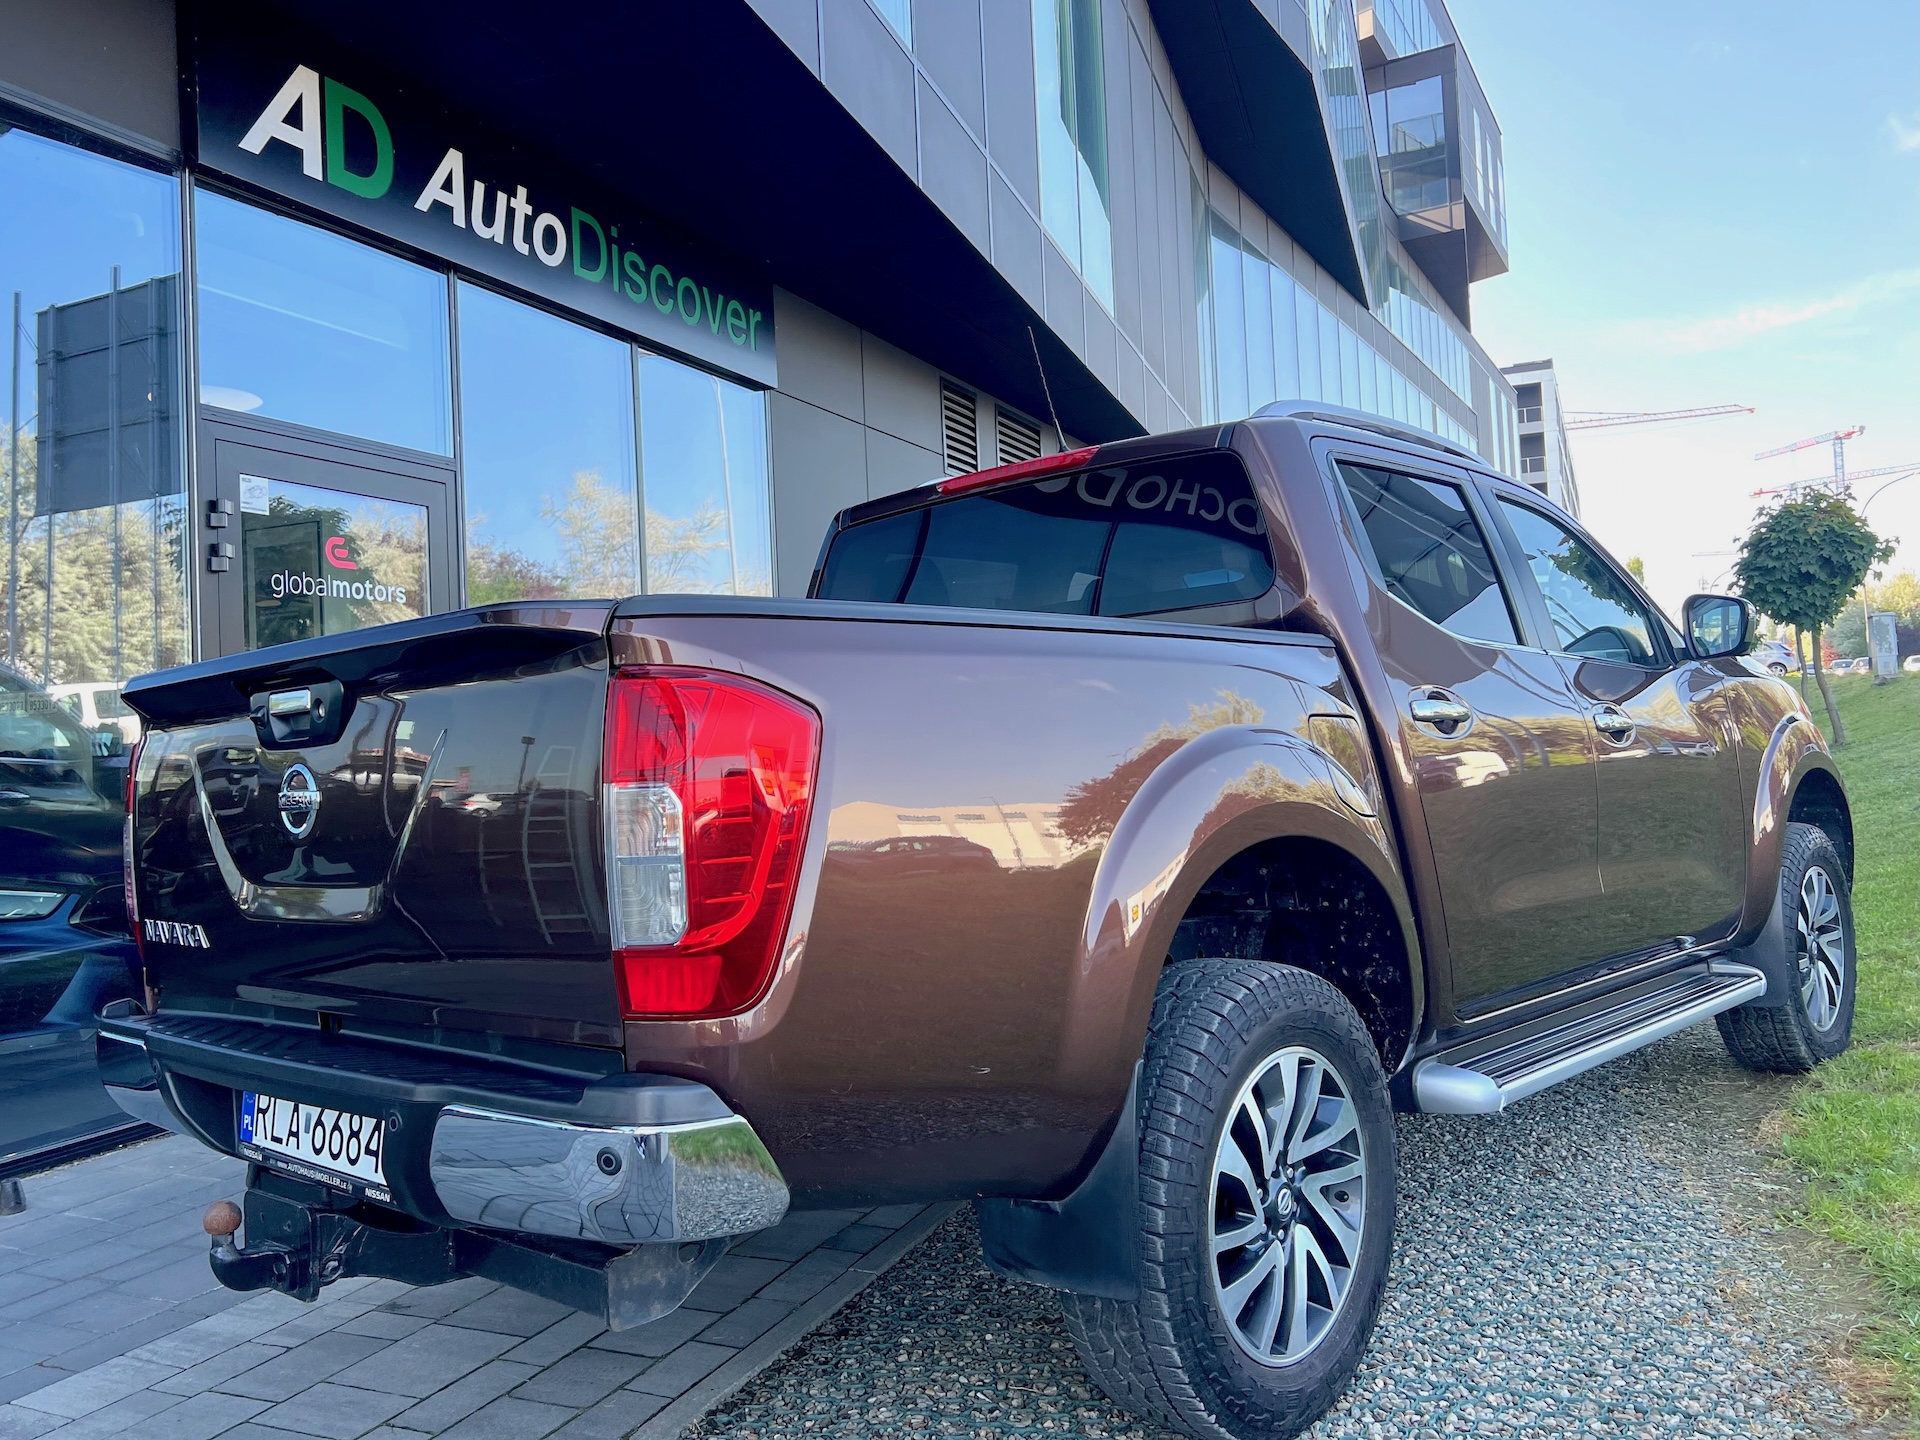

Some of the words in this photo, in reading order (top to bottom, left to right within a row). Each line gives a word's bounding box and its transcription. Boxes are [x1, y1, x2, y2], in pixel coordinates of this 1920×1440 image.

[413, 147, 763, 352] AutoDiscover
[271, 570, 407, 604] globalmotors
[144, 919, 211, 949] NAVARA
[243, 1114, 253, 1131] PL
[243, 1149, 263, 1162] NISSAN
[364, 1187, 391, 1203] NISSAN
